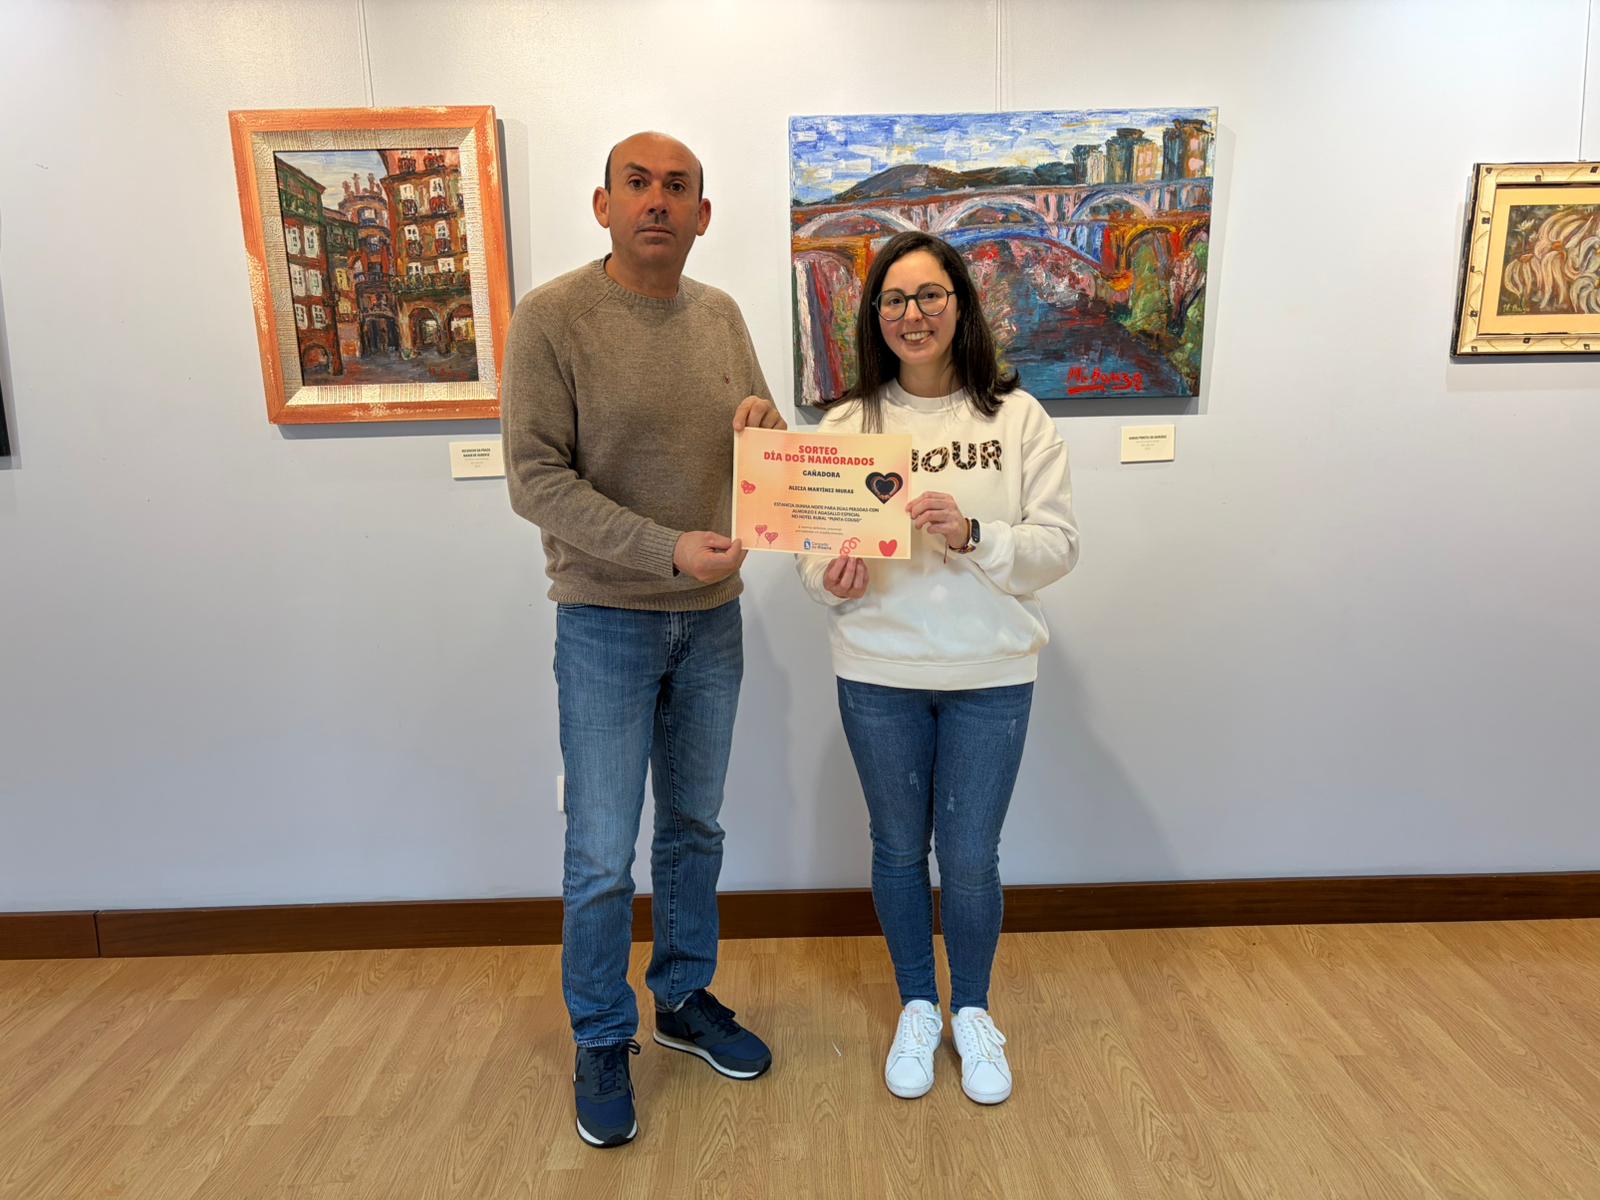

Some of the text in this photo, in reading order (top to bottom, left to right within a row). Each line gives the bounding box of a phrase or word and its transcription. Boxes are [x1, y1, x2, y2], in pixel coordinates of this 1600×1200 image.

[798, 445, 838, 456] SORTEO
[763, 450, 875, 466] DÍA DOS NAMORADOS
